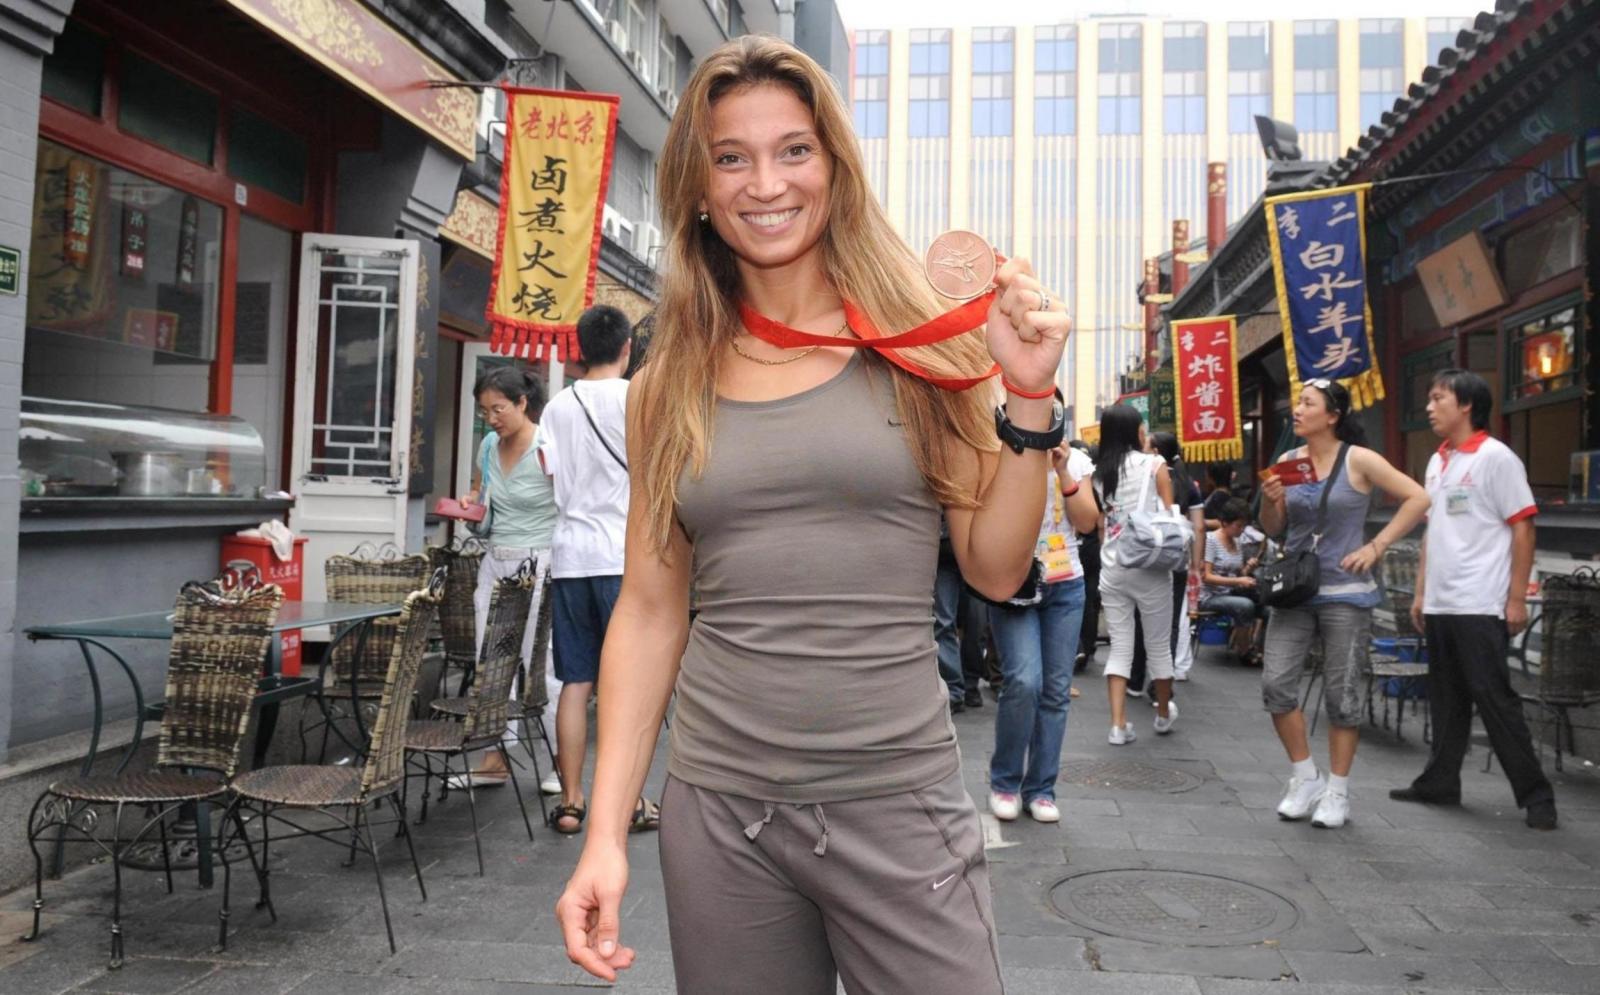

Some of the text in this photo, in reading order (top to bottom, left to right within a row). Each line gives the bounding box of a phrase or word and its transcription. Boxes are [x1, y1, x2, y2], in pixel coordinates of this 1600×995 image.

[519, 105, 597, 145] 老北京
[511, 154, 568, 322] 卤煮火烧
[1277, 206, 1301, 240] 李
[1299, 240, 1363, 372] 白水羊头
